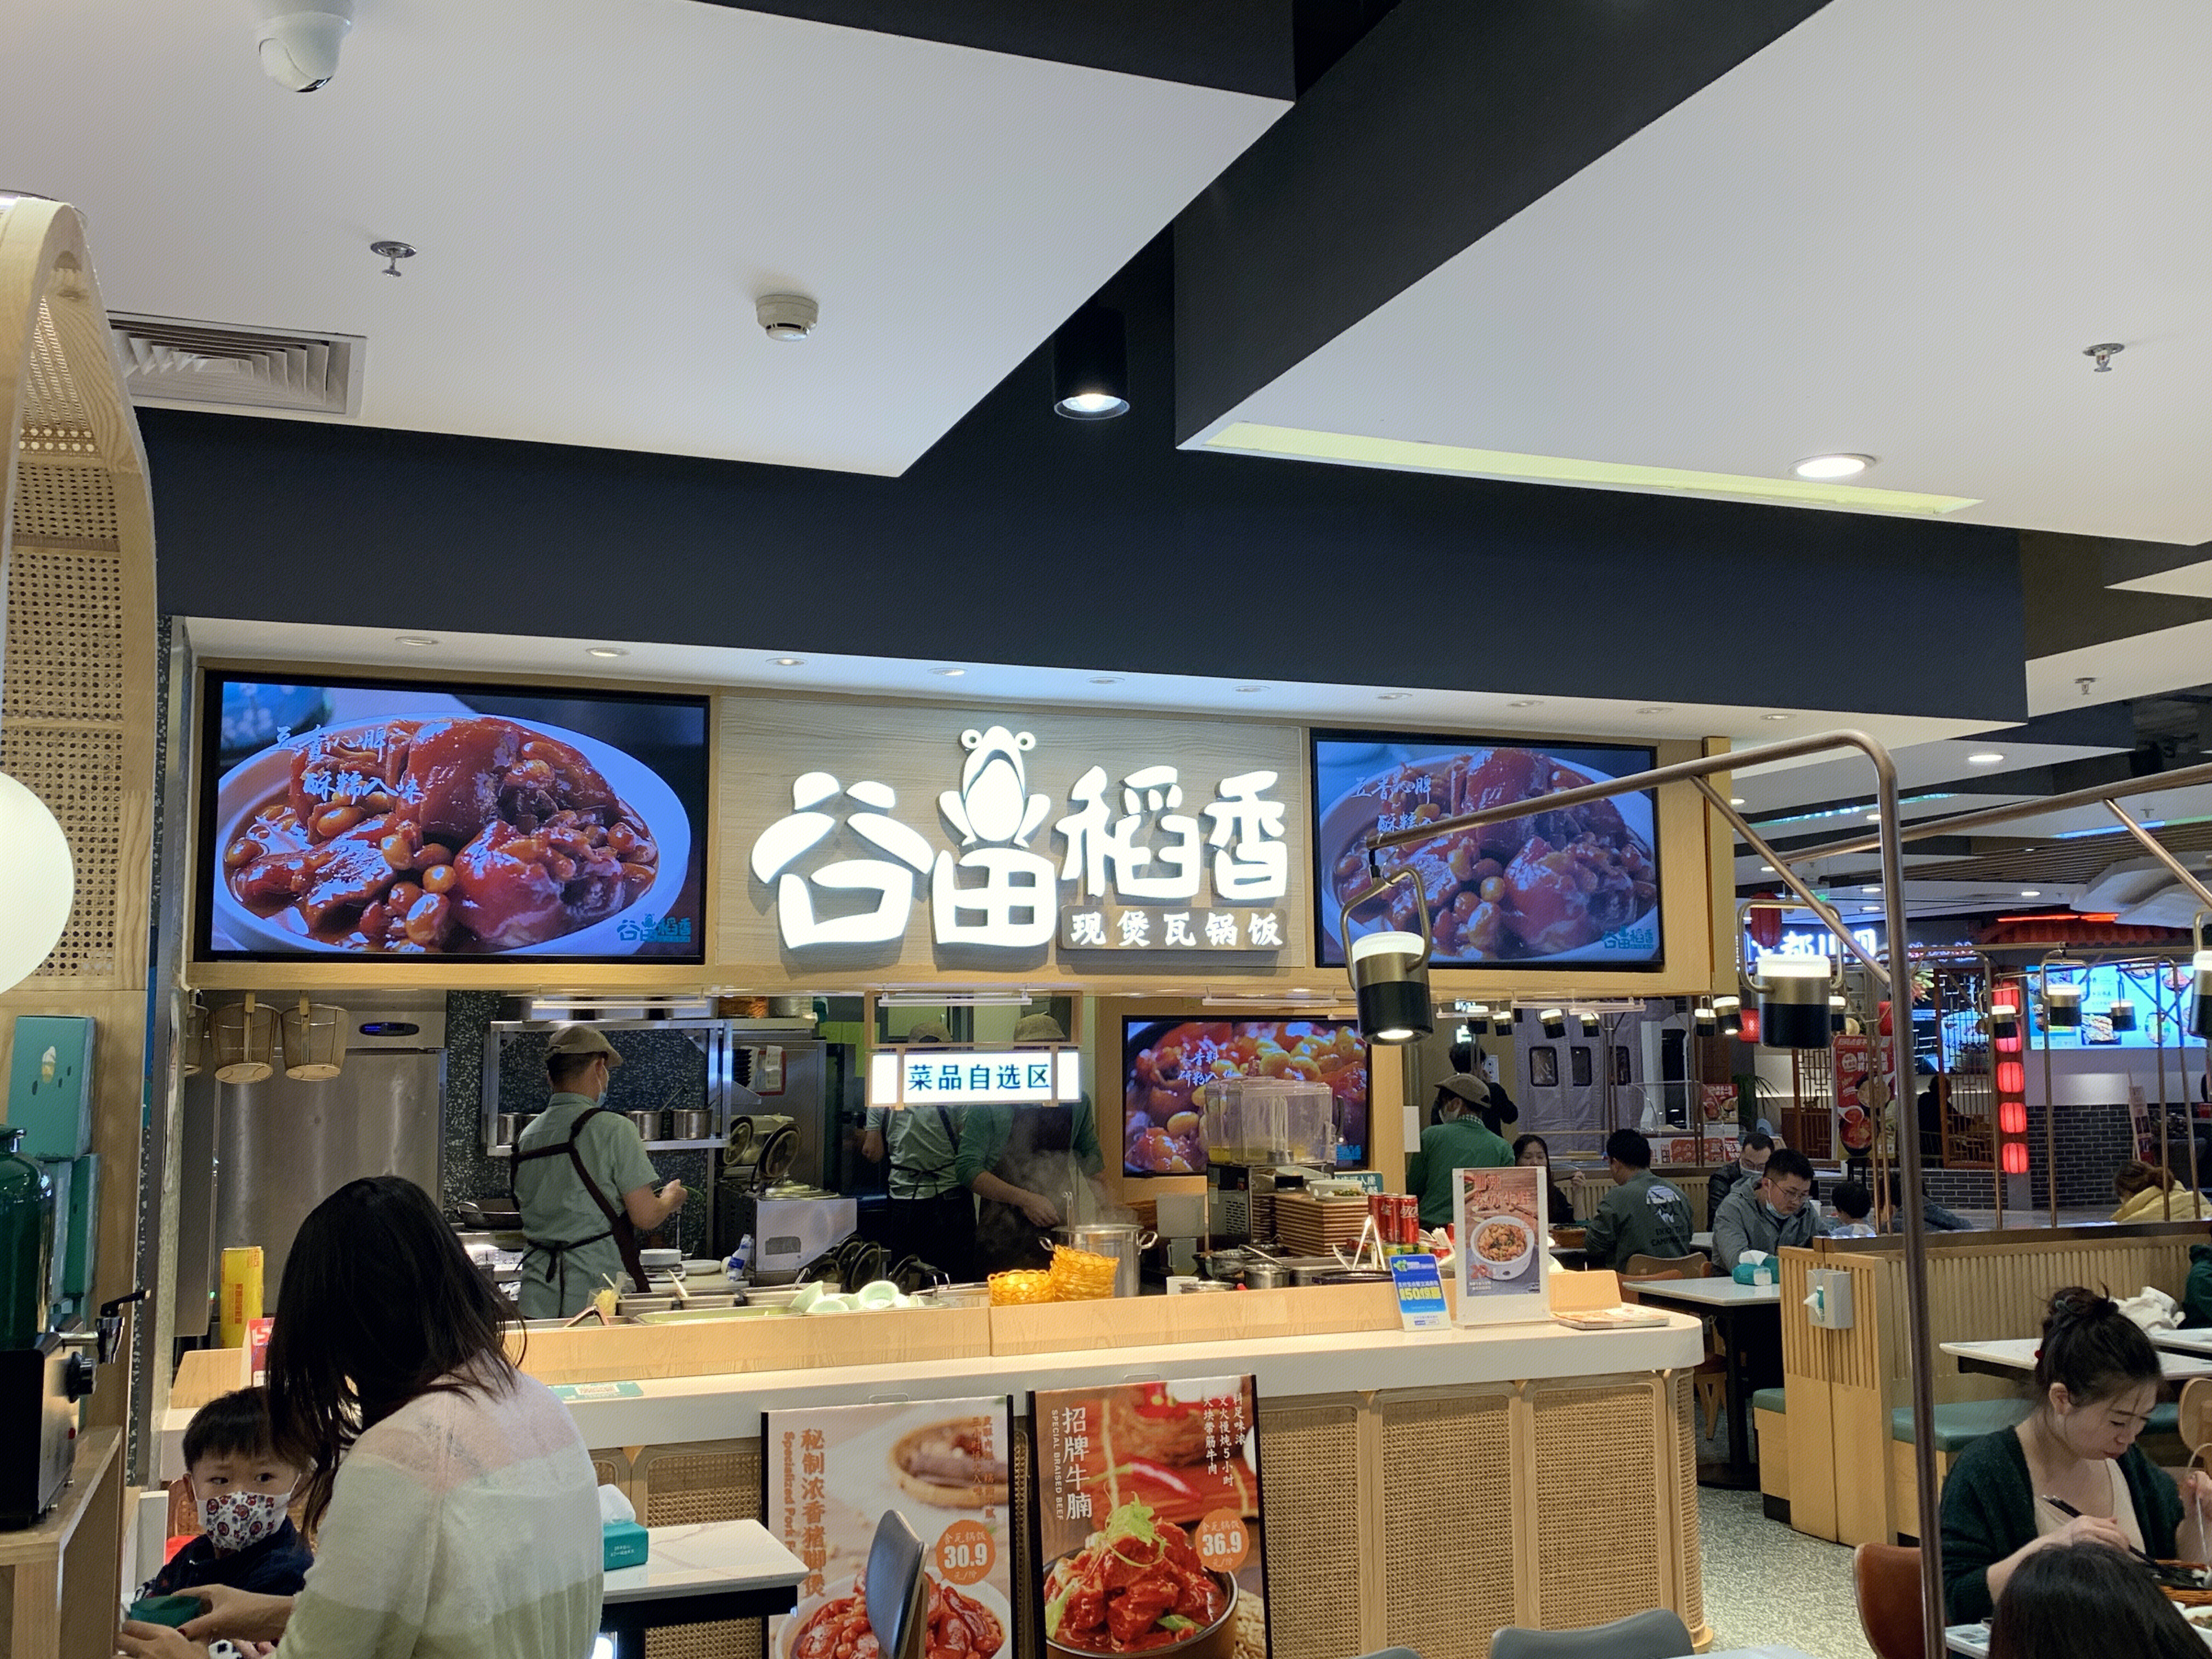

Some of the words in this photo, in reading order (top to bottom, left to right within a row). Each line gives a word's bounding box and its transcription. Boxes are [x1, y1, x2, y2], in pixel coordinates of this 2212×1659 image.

[303, 770, 424, 805] 酥糯入味
[1070, 909, 1283, 948] 现煲瓦锅饭
[908, 1063, 1051, 1091] 菜品自选区
[1052, 1409, 1060, 1449] SPECIAL
[1203, 1397, 1218, 1476] 大块带筋牛肉
[1233, 1392, 1246, 1445] 料足味浓
[1218, 1395, 1234, 1487] 文火慢炖5小时
[782, 1431, 795, 1505] Specialized
[1054, 1452, 1062, 1494] BRAISED
[1062, 1406, 1093, 1521] 招牌牛腩
[784, 1508, 795, 1537] Pork
[1056, 1497, 1064, 1521] BEEF
[944, 1543, 988, 1569] 30.9
[1202, 1531, 1242, 1557] 36.9
